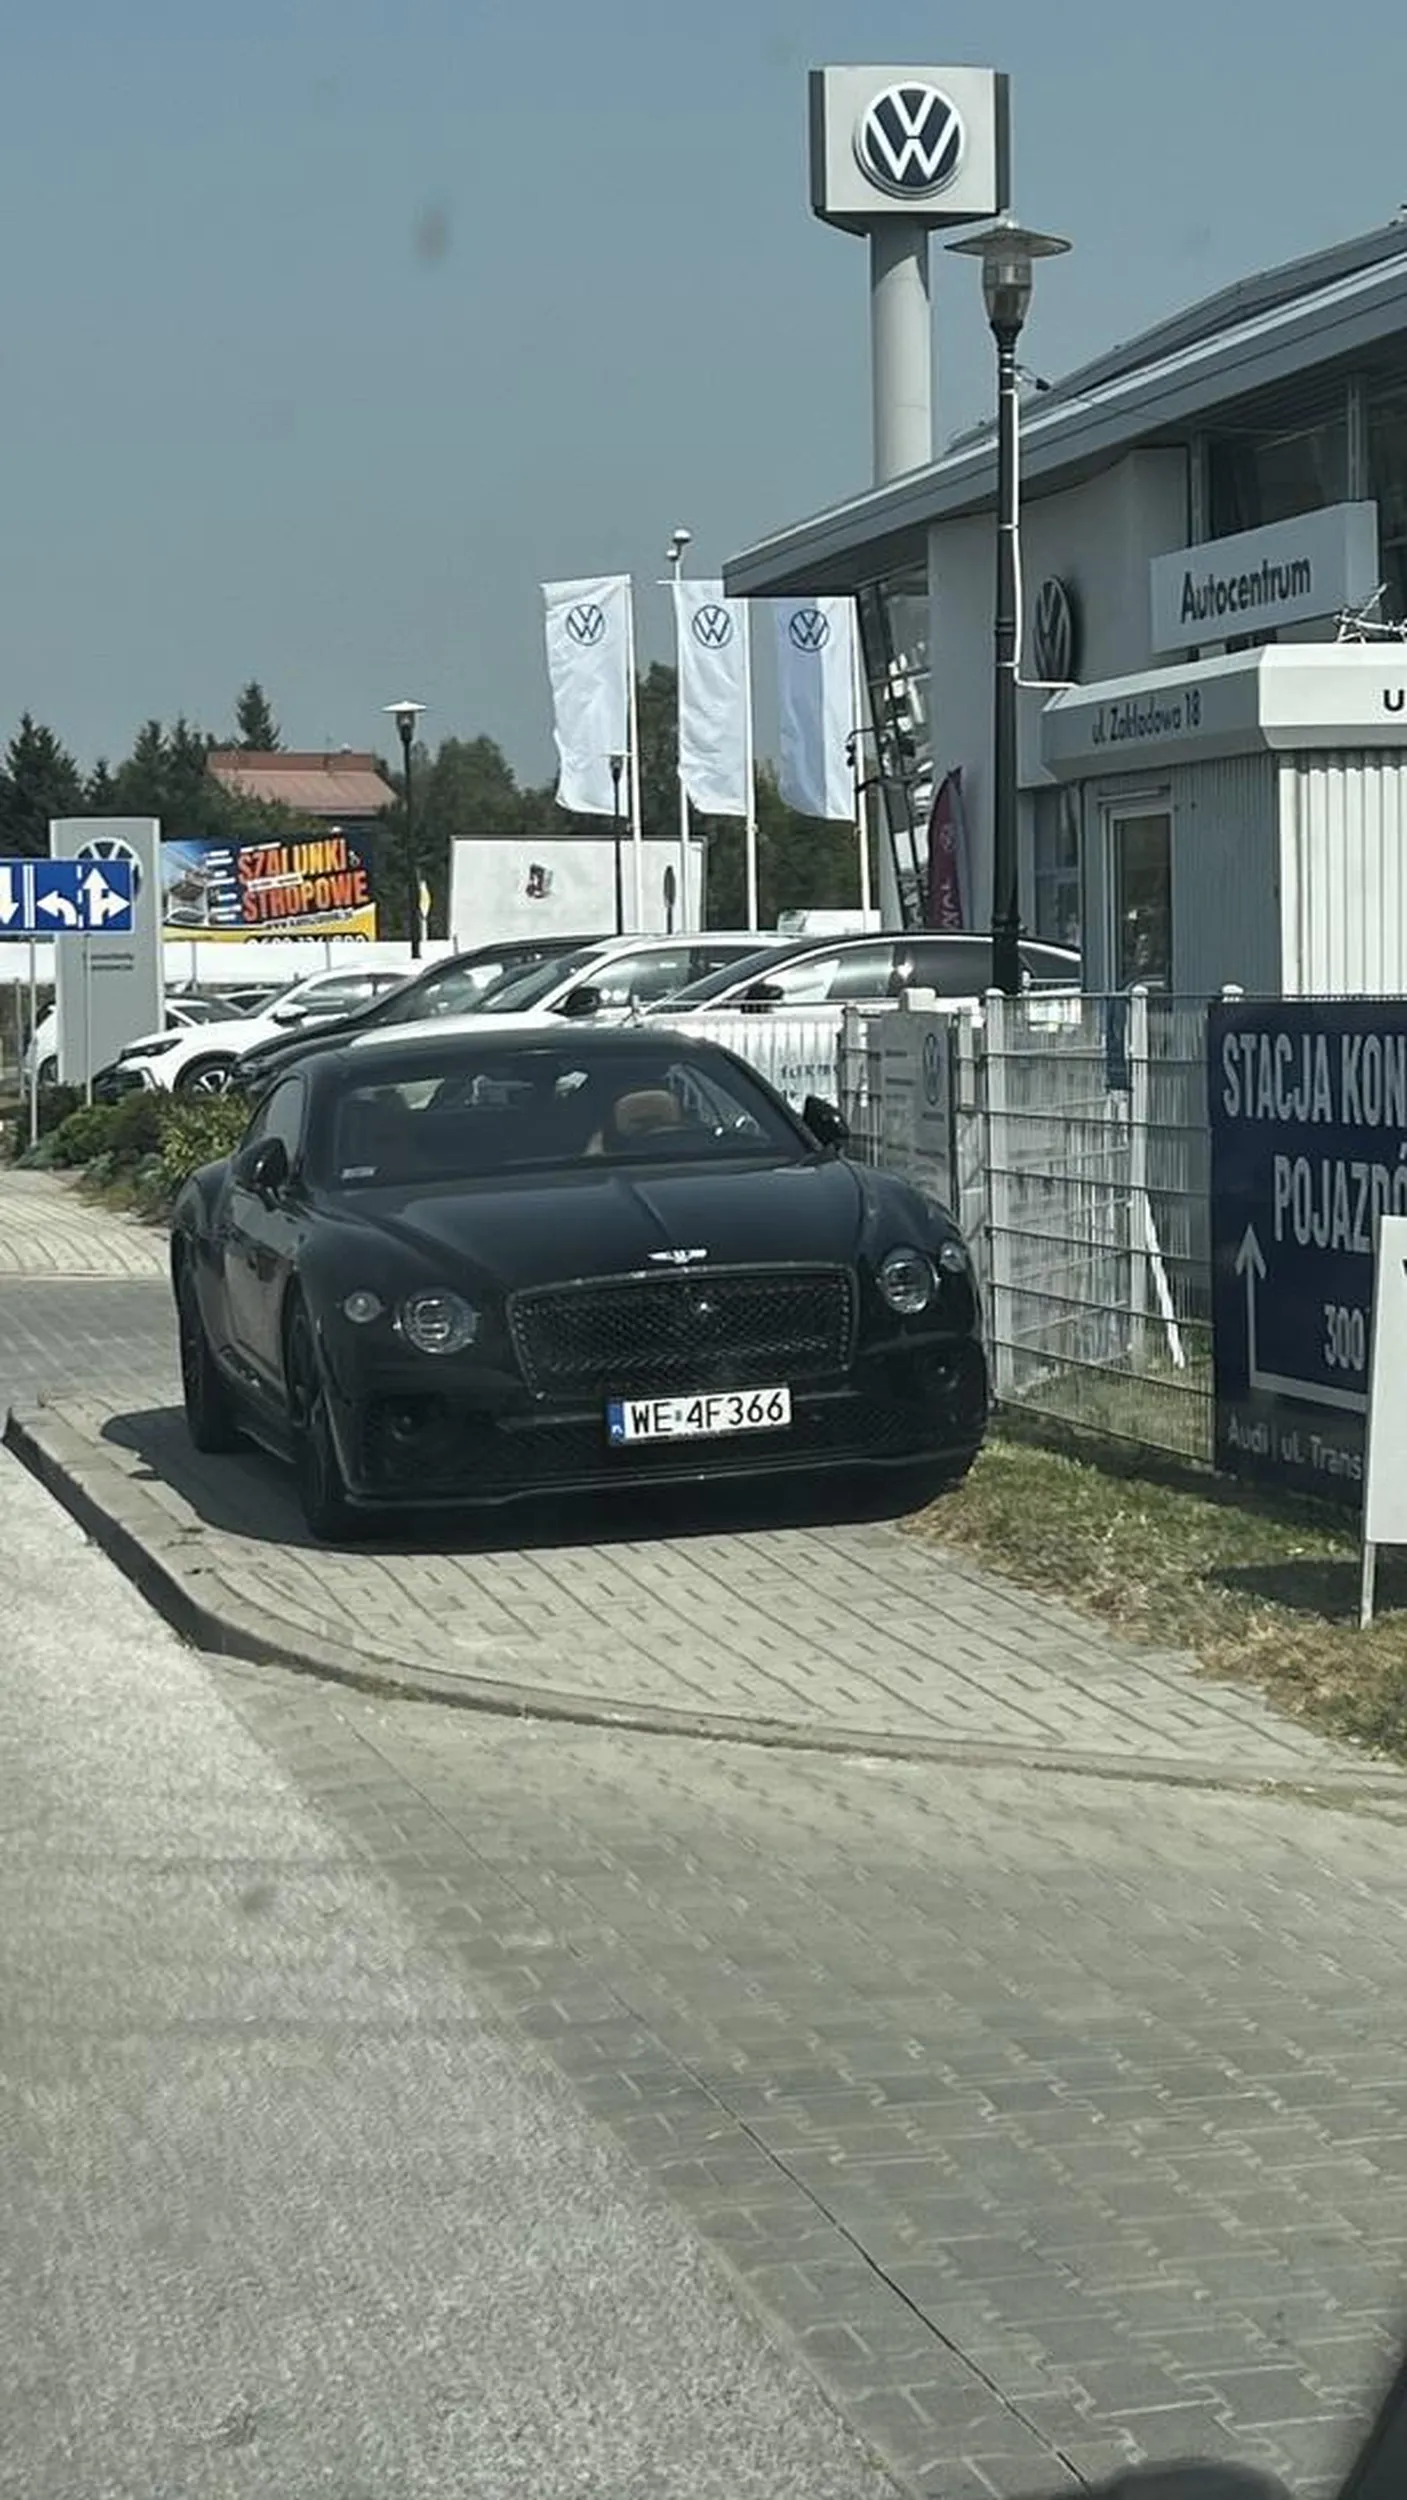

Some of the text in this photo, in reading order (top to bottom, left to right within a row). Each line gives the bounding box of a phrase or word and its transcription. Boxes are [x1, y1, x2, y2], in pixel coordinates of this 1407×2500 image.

[1181, 557, 1311, 624] Autocentrum
[1185, 689, 1200, 729] 18
[238, 838, 347, 886] SZALUNKI
[1223, 1032, 1407, 1128] STACJA KON
[1324, 1304, 1365, 1372] 300
[631, 1402, 673, 1434] WE
[686, 1391, 784, 1429] 4F366
[1227, 1408, 1269, 1454] Audi
